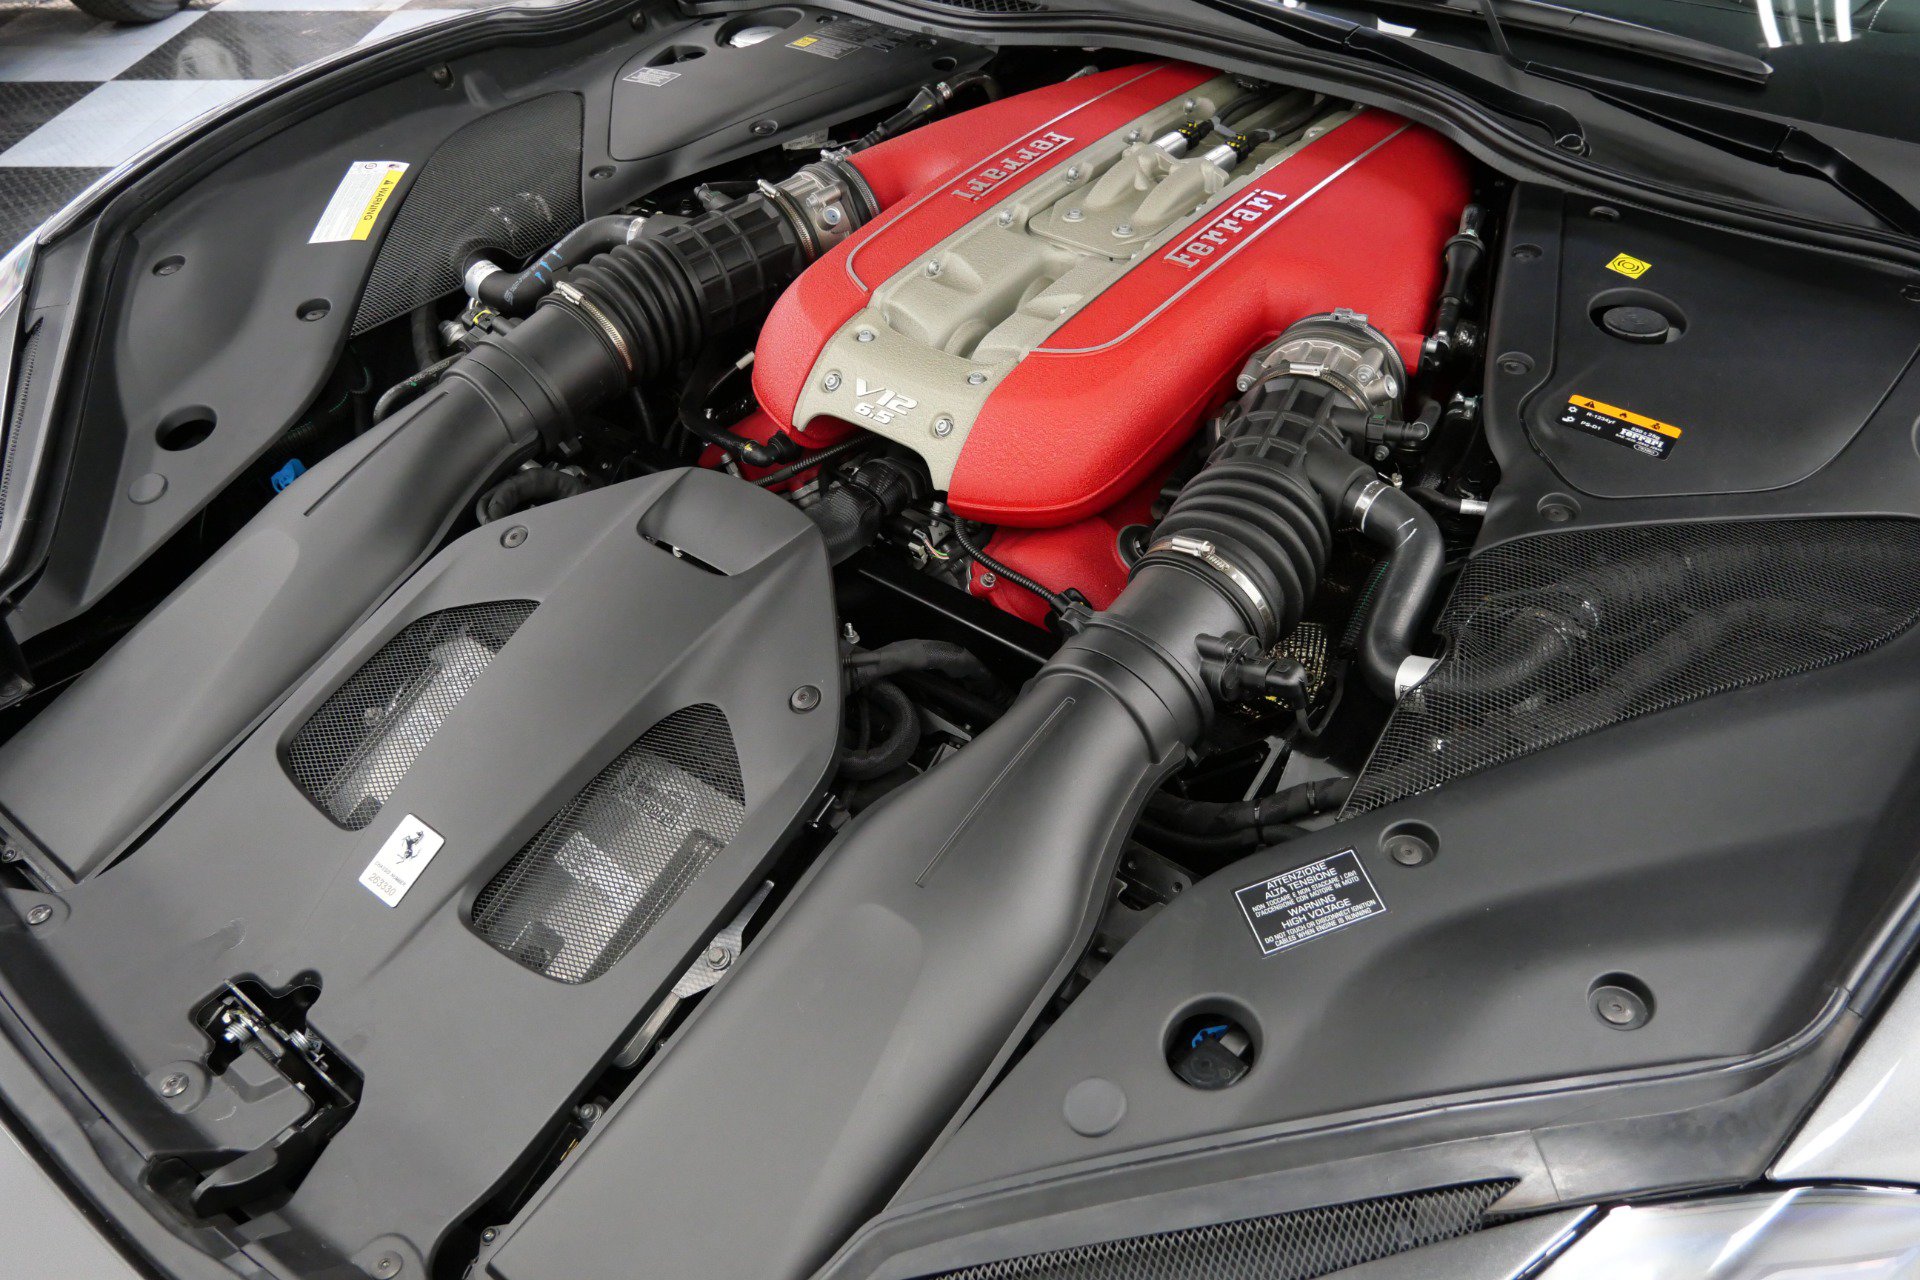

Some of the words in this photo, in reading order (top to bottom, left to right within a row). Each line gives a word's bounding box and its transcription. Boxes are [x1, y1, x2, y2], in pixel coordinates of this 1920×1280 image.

[952, 131, 1075, 202] Ferrari
[363, 187, 389, 221] WARNING
[1163, 188, 1287, 269] Ferrari
[854, 402, 896, 425] 6.5
[856, 378, 919, 416] V12
[1620, 428, 1664, 448] Ferrari
[368, 872, 397, 897] 263330
[1264, 887, 1288, 900] ALTA
[1289, 867, 1338, 890] TENSIONE
[1267, 861, 1328, 890] ATTENZIONE
[1297, 894, 1309, 903] CON
[1310, 885, 1334, 898] MOTORE
[1342, 876, 1360, 886] MOTO
[1252, 902, 1265, 913] NON
[1267, 893, 1291, 908] TOCCARE
[1297, 887, 1311, 897] NON
[1311, 876, 1340, 890] STACCARE
[1287, 893, 1336, 917] WARNING
[1265, 936, 1274, 944] DO
[1274, 931, 1286, 940] NOT
[1286, 924, 1306, 936] TOUCH
[1306, 920, 1316, 928] OR
[1316, 908, 1351, 925] DISCONNECT
[1350, 899, 1377, 912] IGNITION
[1275, 935, 1297, 947] CABLES
[1297, 928, 1315, 939] WHEN
[1316, 920, 1338, 932] ENGINE
[1345, 908, 1372, 921] RUNNING
[1281, 914, 1308, 929] HIGH
[1309, 898, 1352, 920] VOLTAGE
